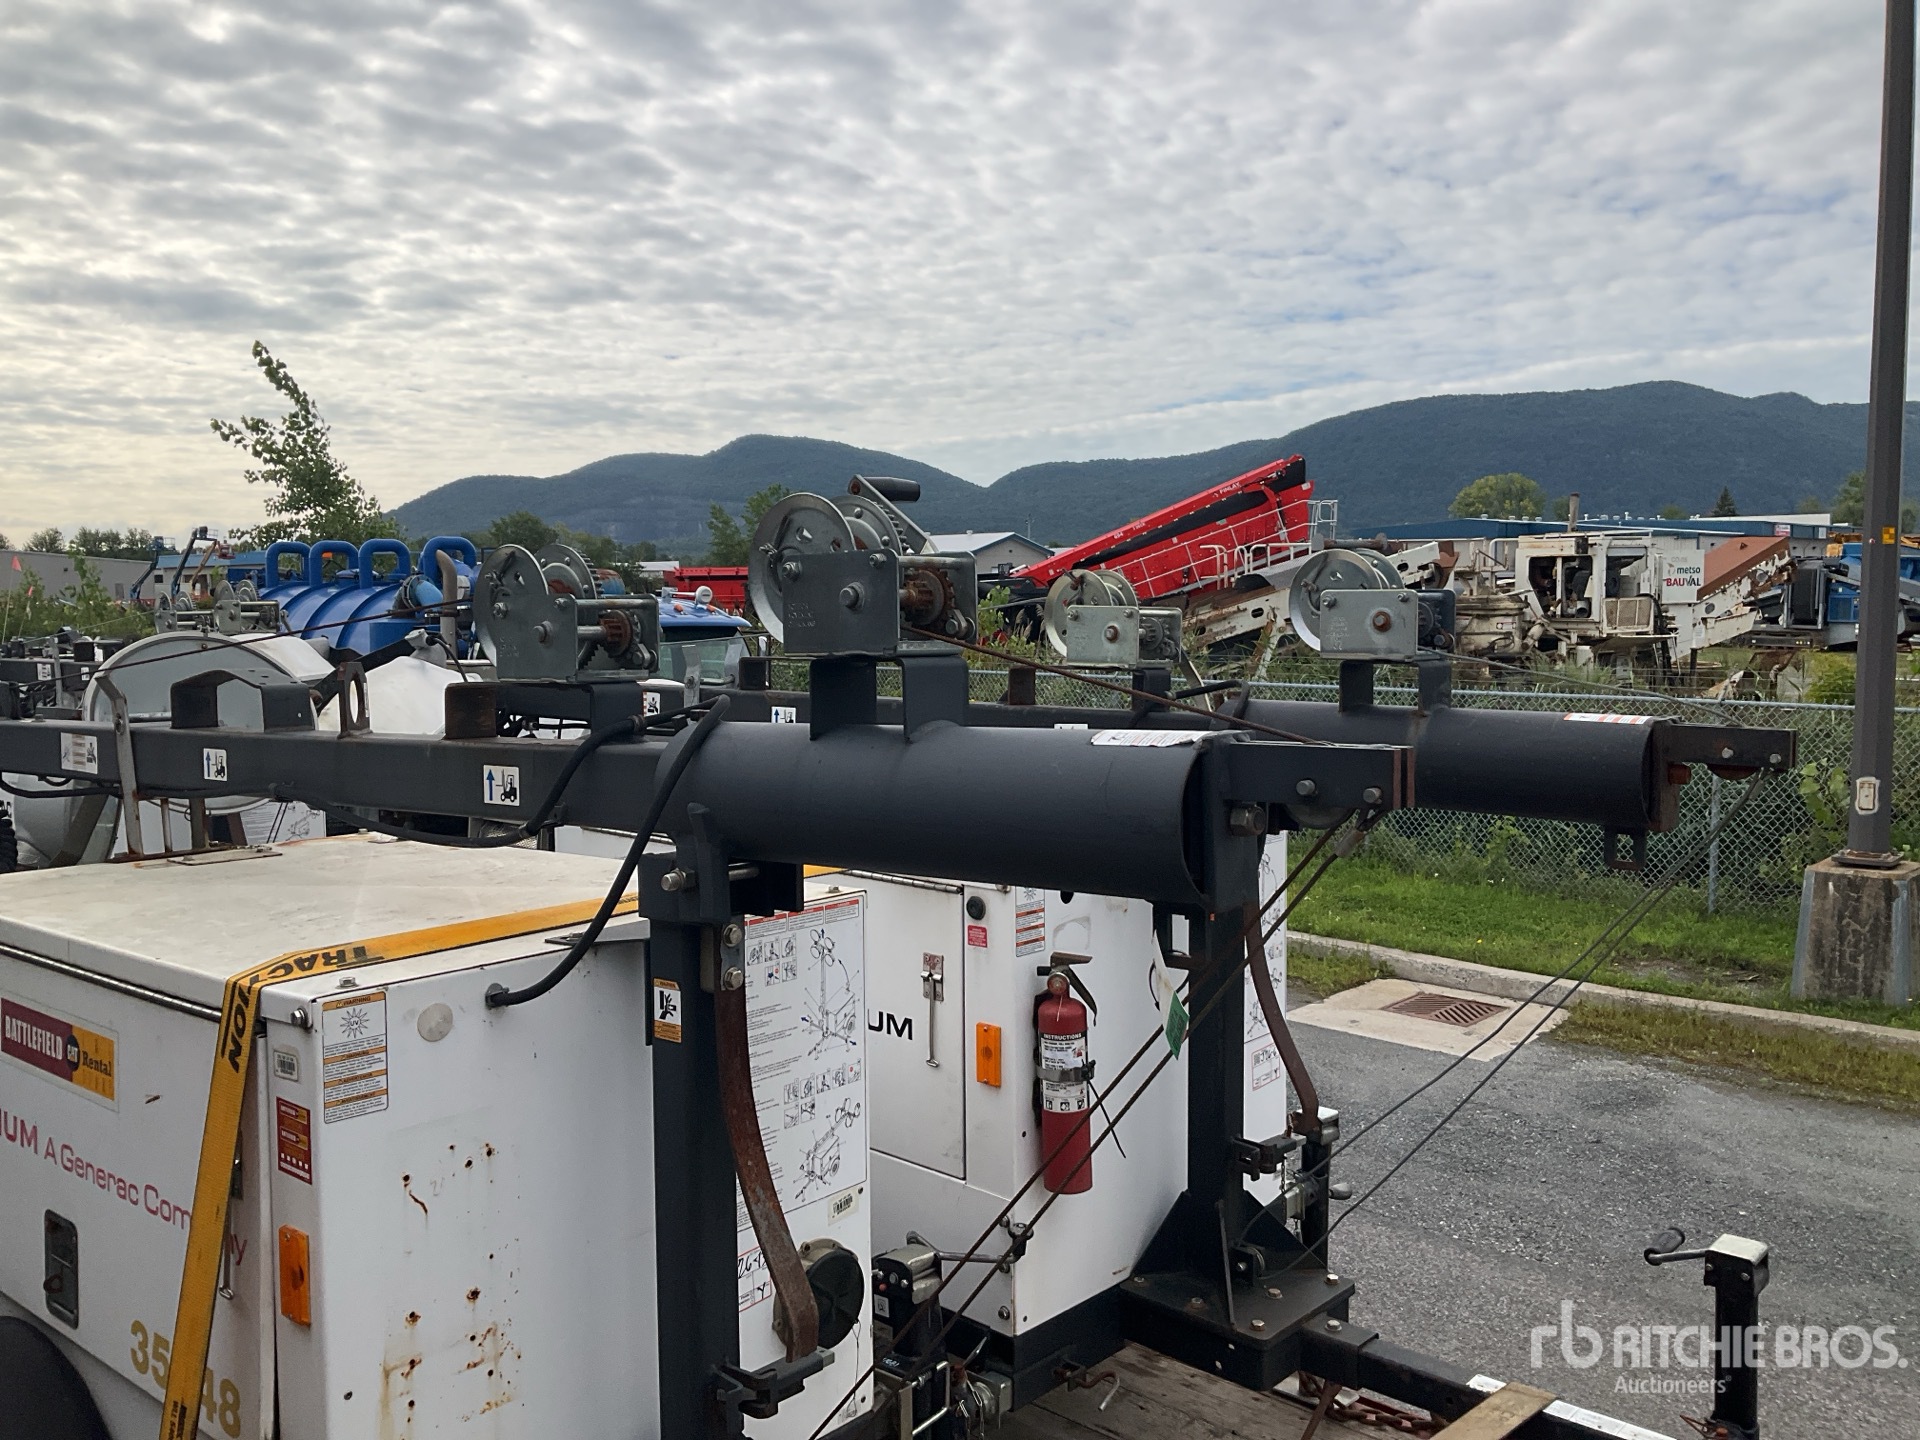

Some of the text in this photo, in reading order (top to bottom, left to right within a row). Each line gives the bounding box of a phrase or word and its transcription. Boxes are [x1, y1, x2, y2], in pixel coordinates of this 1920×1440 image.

[1676, 566, 1701, 574] metso
[1666, 575, 1702, 587] BAUVAL
[349, 1019, 359, 1027] UV
[1043, 1032, 1082, 1041] INSTRUCTIONS
[5, 1014, 63, 1061] BATTLEFIELD
[81, 1050, 112, 1078] Rental
[44, 1136, 58, 1165] A
[60, 1143, 139, 1206] Generac
[143, 1184, 248, 1266] Comy
[130, 1320, 241, 1439] 3548
